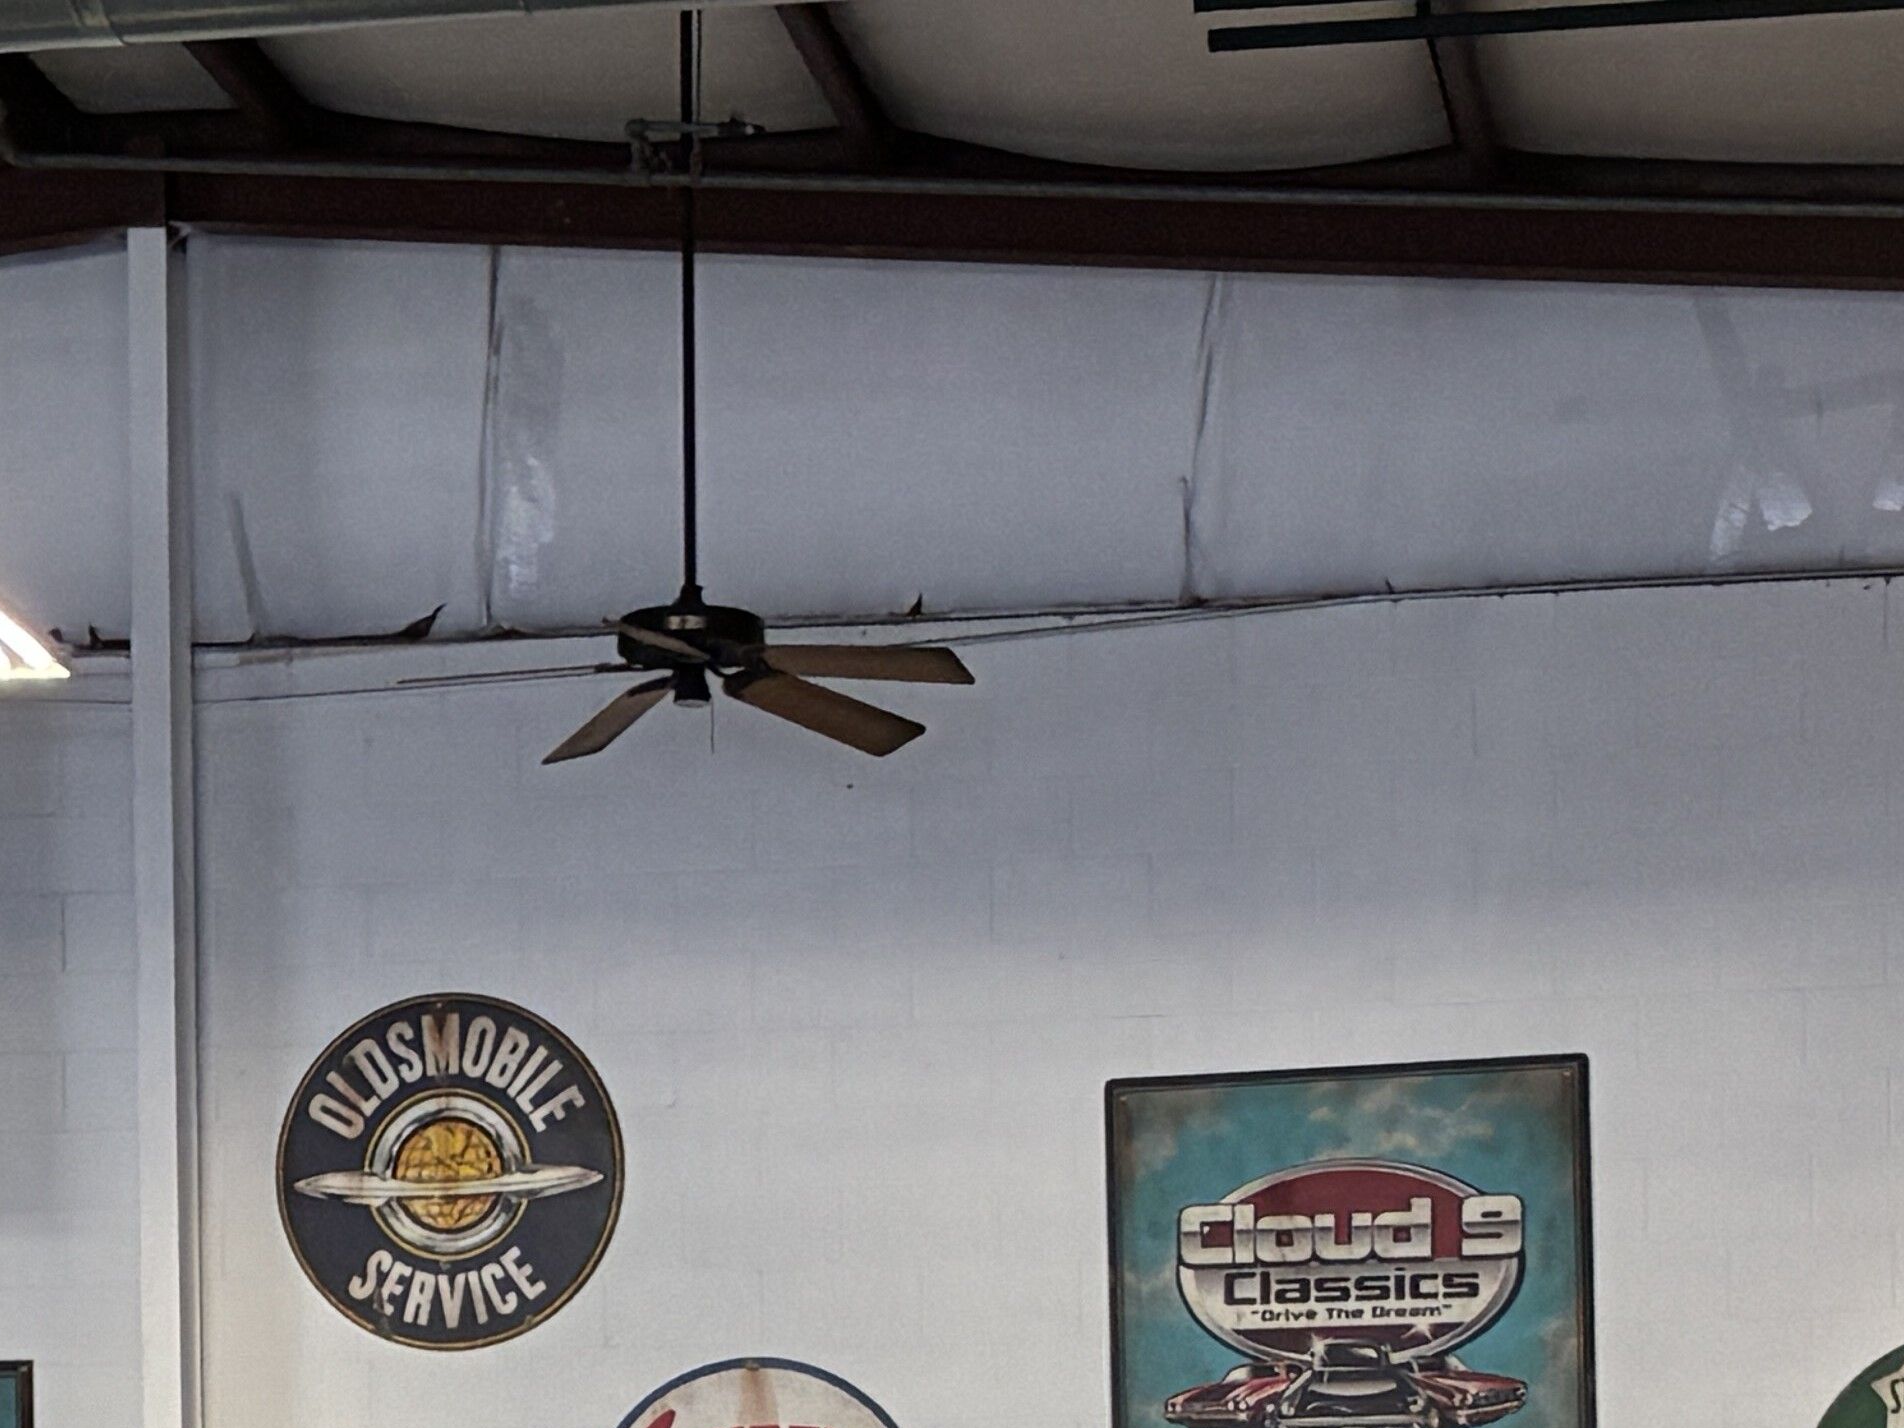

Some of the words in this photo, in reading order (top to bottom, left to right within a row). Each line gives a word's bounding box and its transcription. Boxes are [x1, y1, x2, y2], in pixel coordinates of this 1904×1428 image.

[307, 1012, 586, 1140] OLDSMOBILE
[1179, 1196, 1432, 1265] Cloud
[1460, 1193, 1523, 1258] 9
[348, 1245, 547, 1330] SERVICE
[1223, 1267, 1481, 1306] Classics
[1325, 1306, 1365, 1320] The
